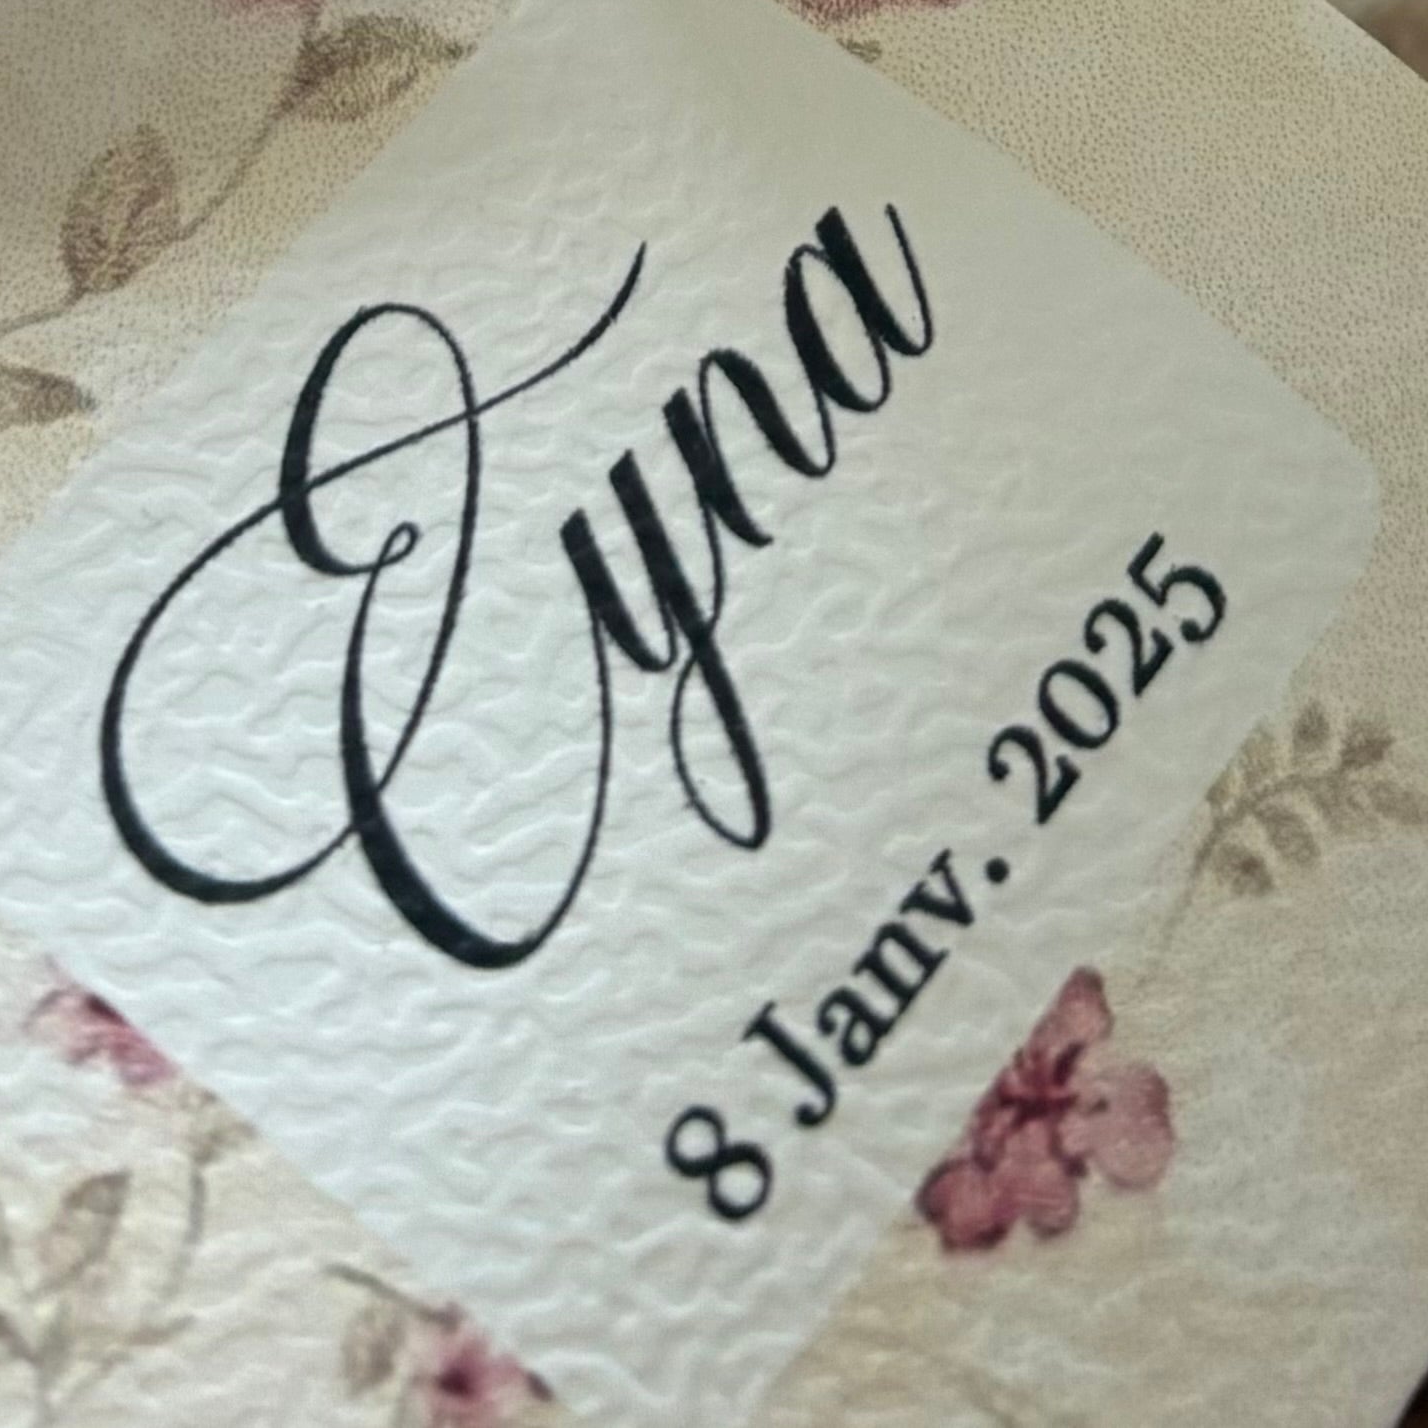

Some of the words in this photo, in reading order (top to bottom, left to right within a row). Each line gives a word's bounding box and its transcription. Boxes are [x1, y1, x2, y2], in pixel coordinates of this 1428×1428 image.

[98, 200, 936, 972] Eyna
[662, 1101, 776, 1225] 8
[740, 847, 1012, 1130] Janv.
[985, 529, 1229, 826] 2025
